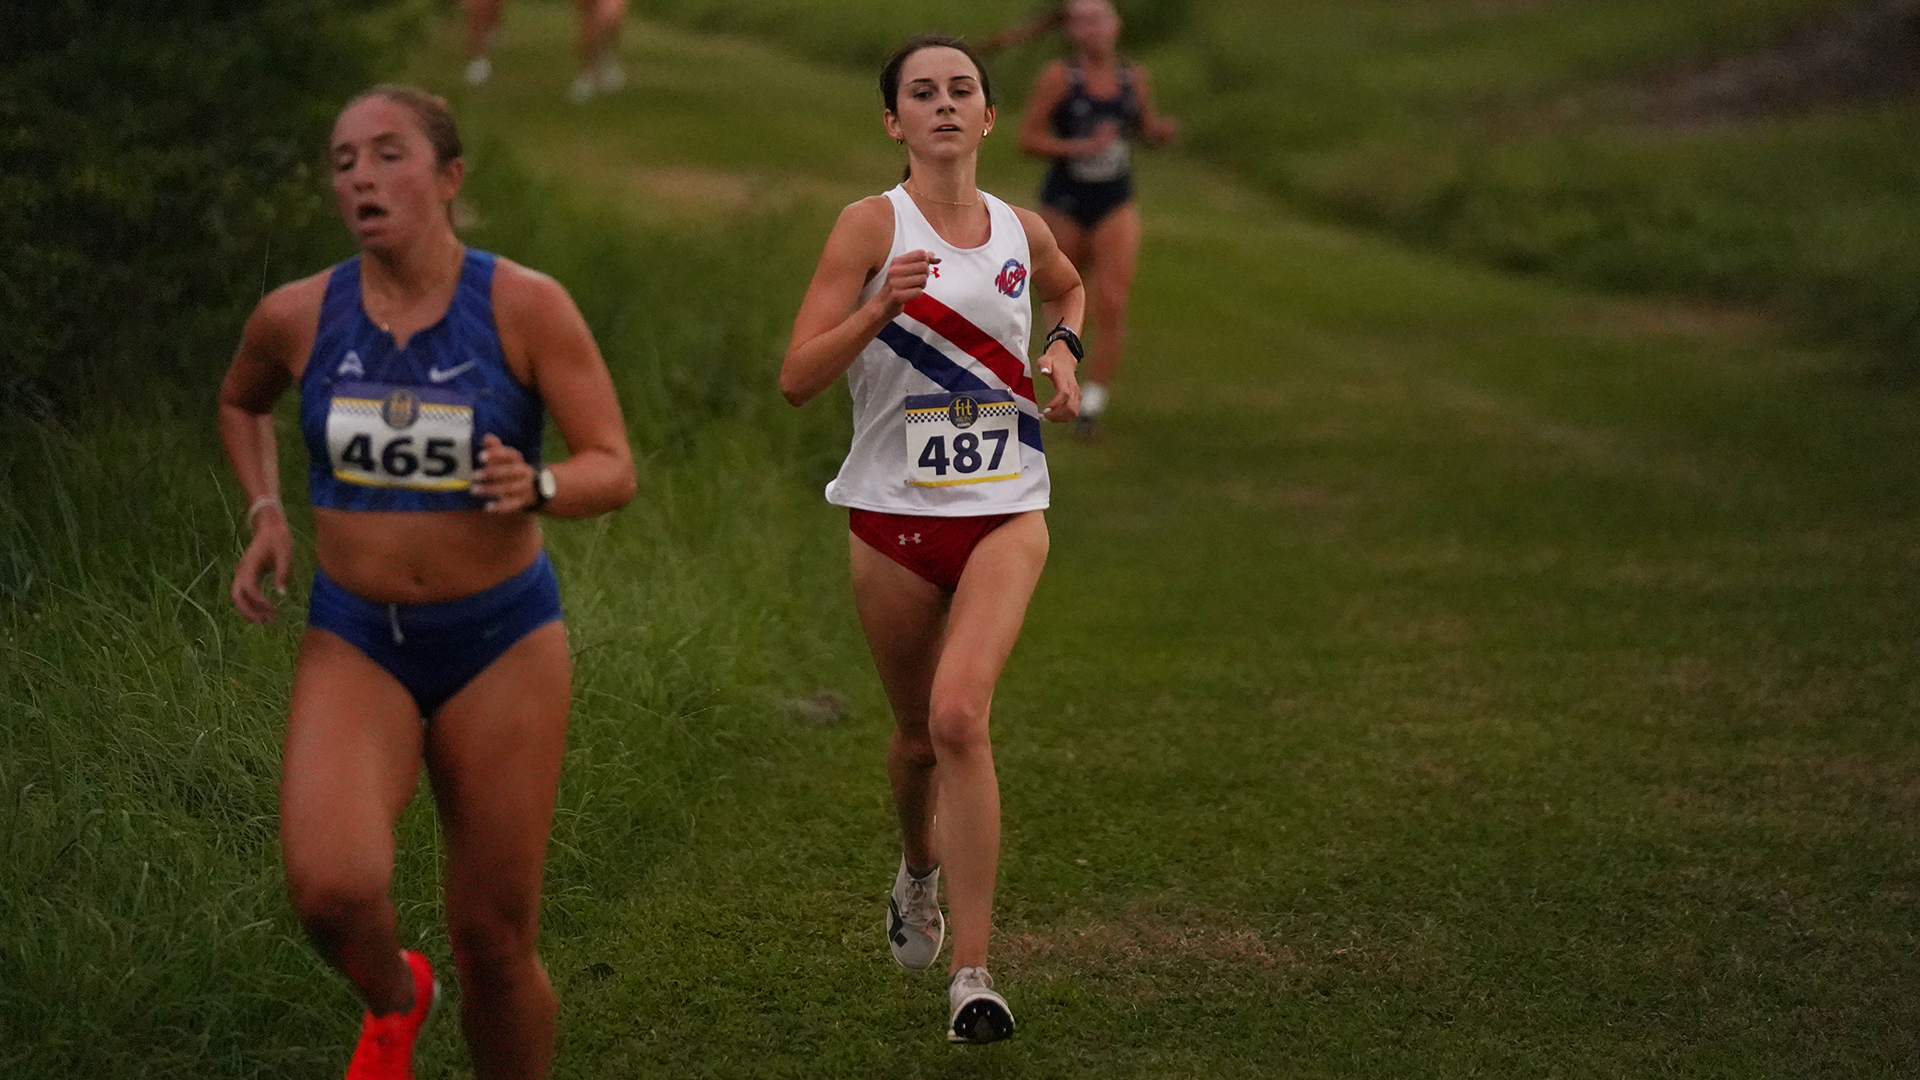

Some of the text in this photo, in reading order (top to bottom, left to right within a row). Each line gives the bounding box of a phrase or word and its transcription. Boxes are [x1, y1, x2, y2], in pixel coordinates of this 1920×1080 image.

[954, 399, 972, 416] fit
[341, 433, 458, 477] 465
[918, 429, 1009, 476] 487
